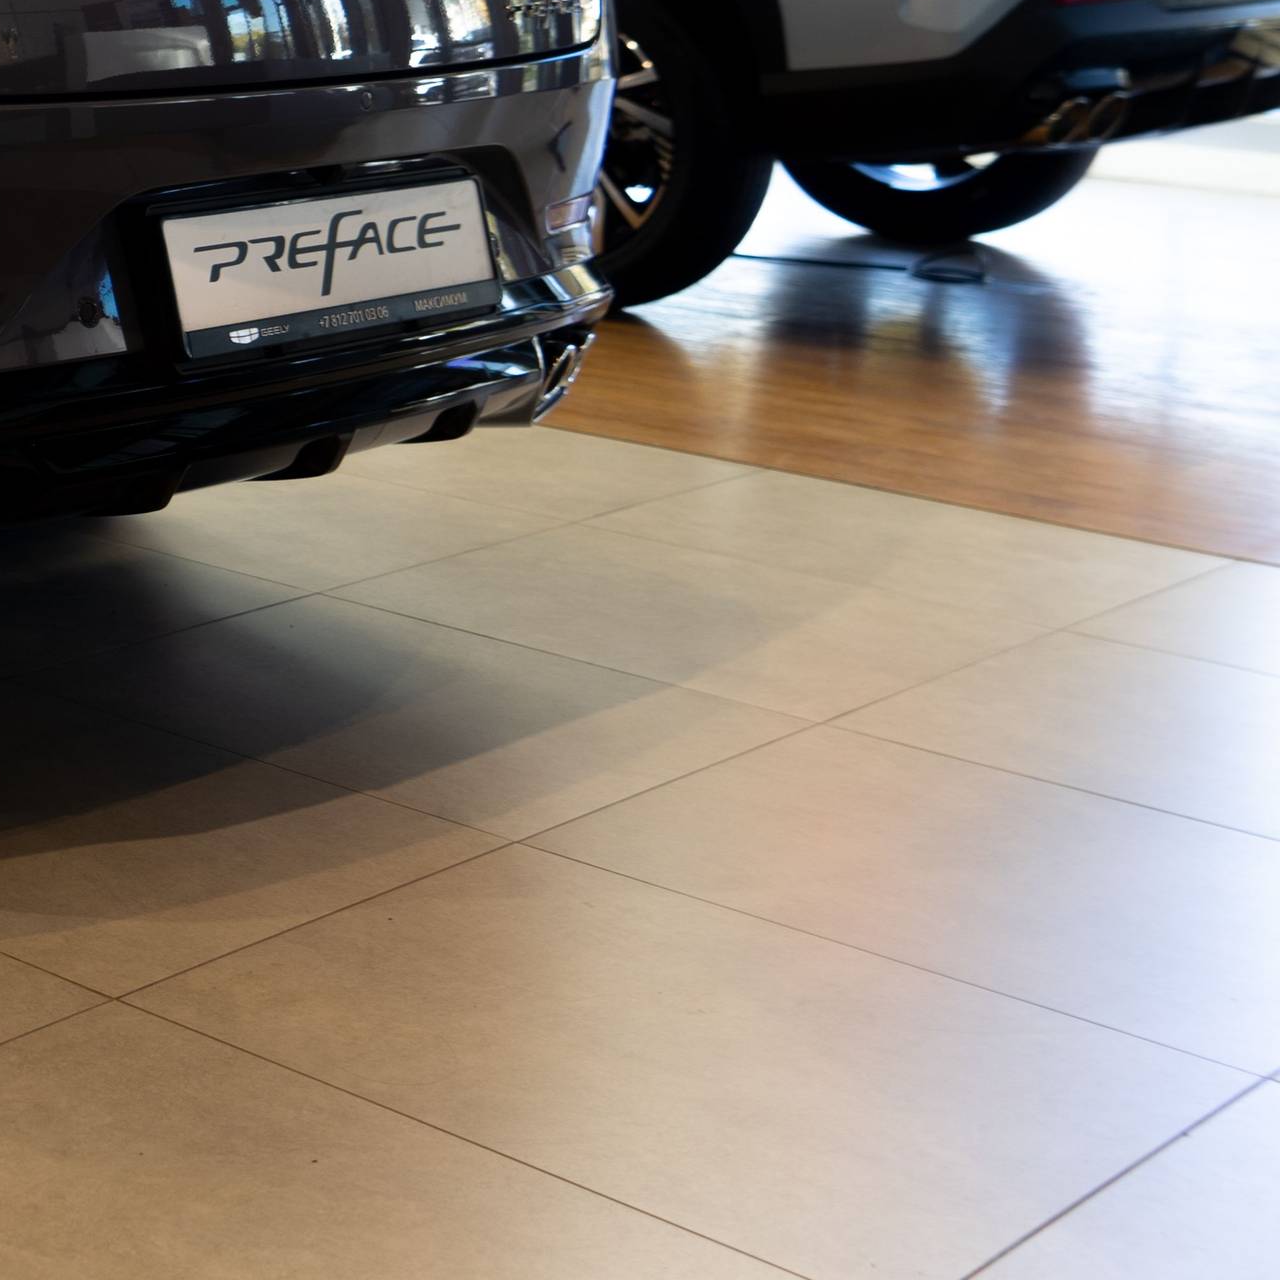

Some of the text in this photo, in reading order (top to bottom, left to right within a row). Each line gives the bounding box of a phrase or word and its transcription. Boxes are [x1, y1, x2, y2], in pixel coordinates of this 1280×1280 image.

[193, 209, 462, 297] PREFACE
[260, 324, 290, 337] GEELY
[319, 315, 330, 328] +7
[348, 310, 363, 324] 701
[377, 305, 389, 318] 06
